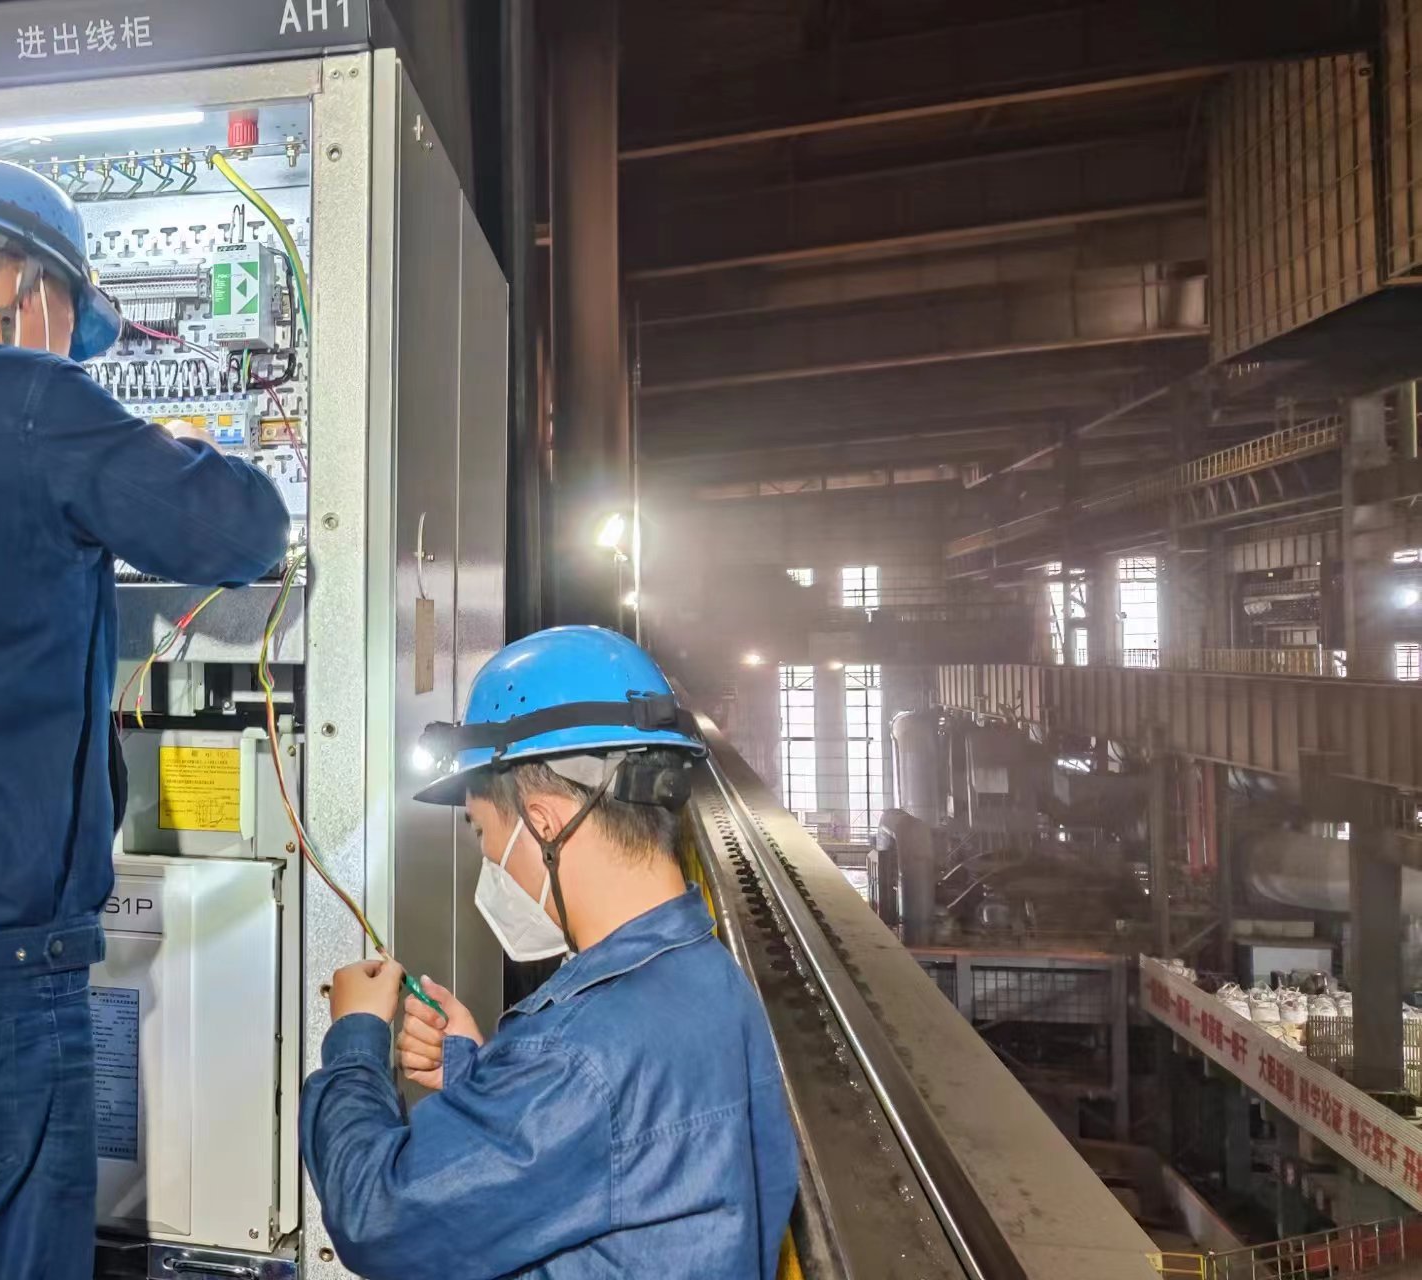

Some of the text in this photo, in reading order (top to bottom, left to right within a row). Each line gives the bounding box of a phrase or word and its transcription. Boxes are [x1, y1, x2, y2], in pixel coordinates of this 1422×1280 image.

[279, 0, 349, 34] AH1
[16, 15, 153, 59] 进出线柜
